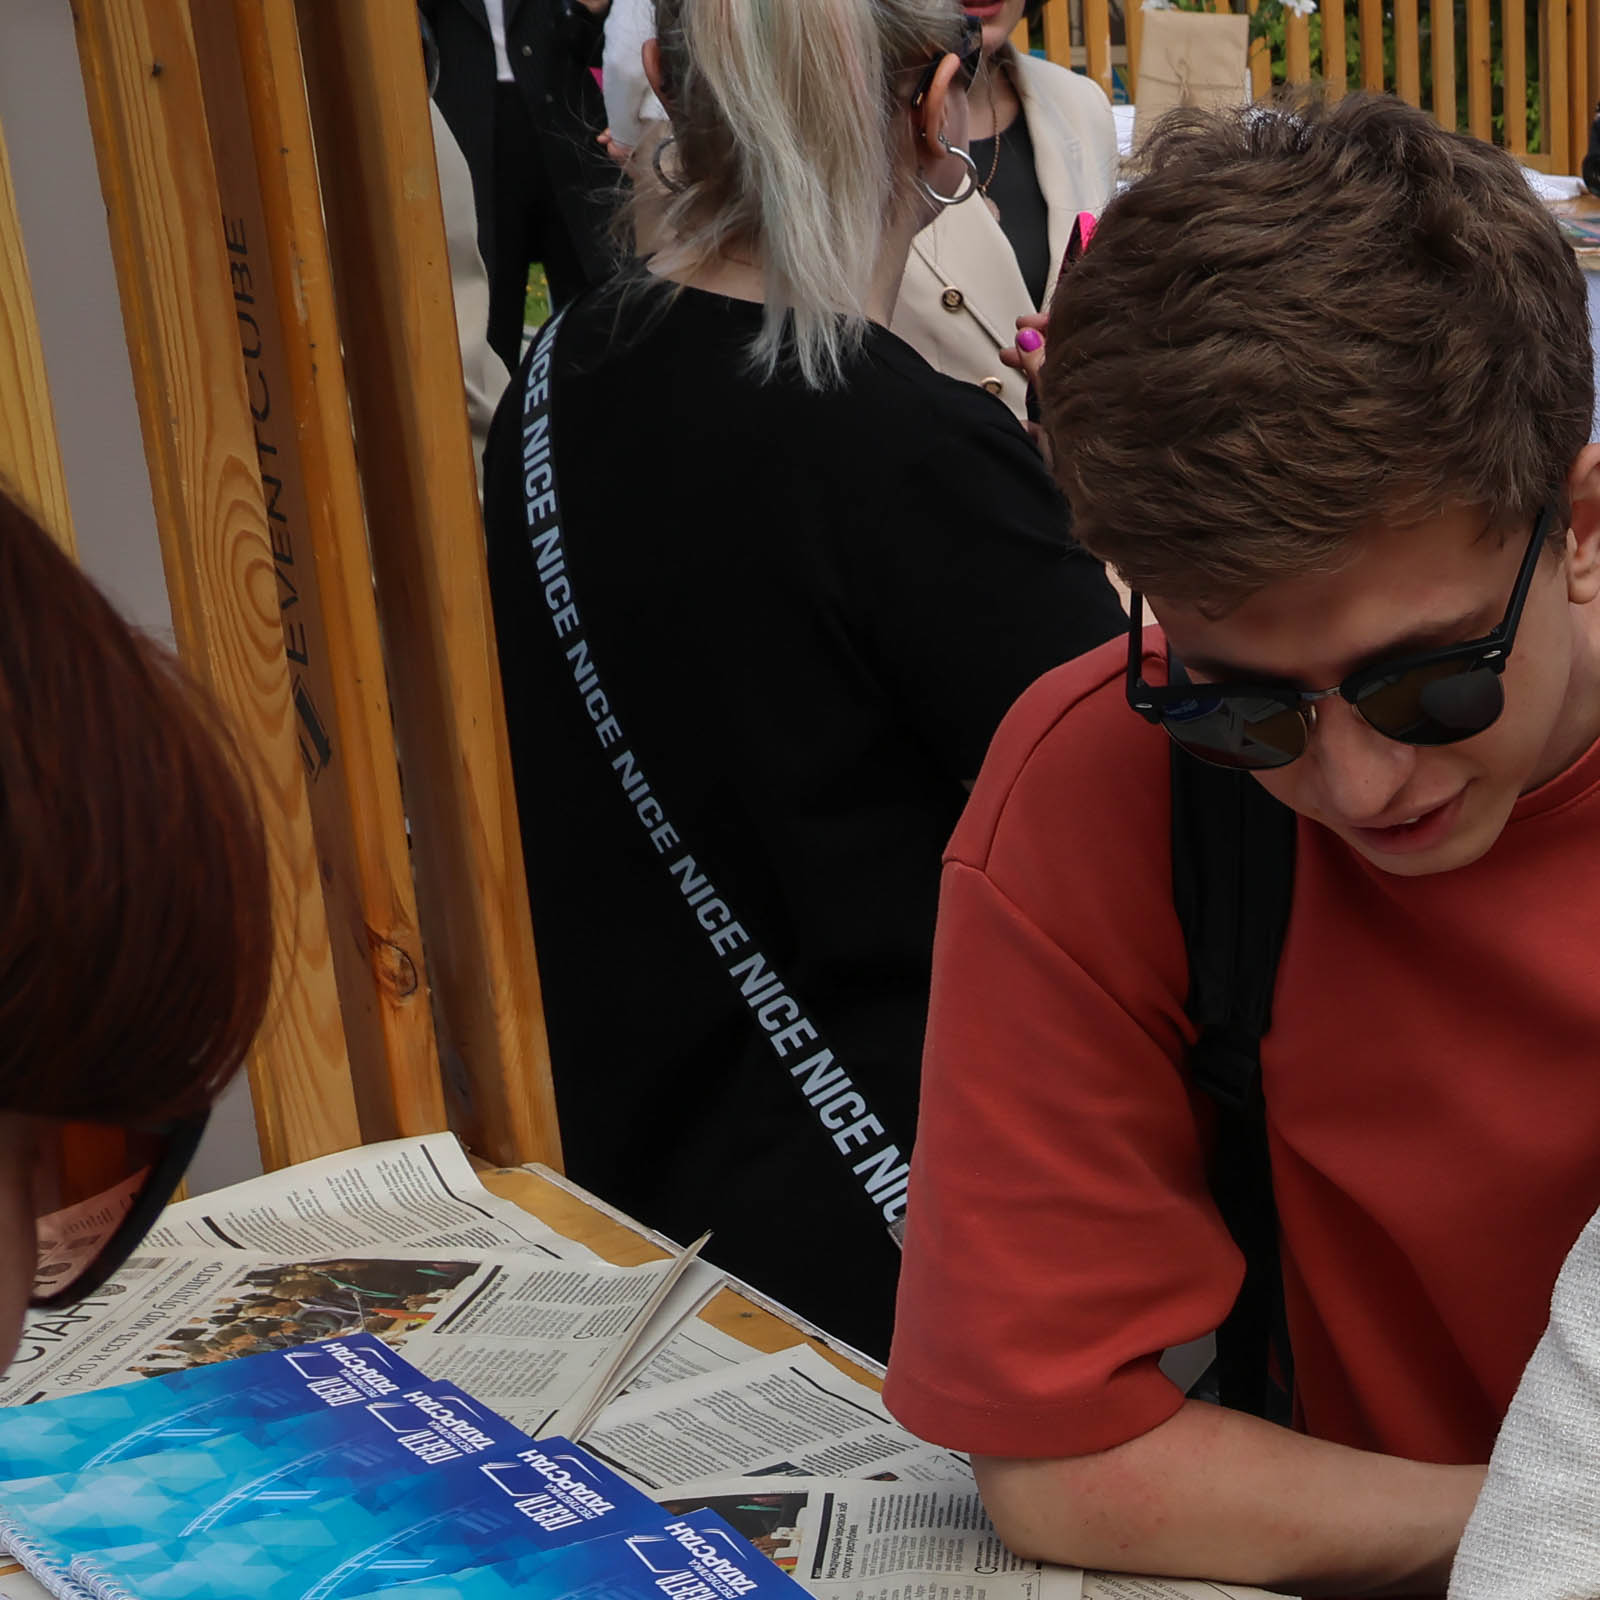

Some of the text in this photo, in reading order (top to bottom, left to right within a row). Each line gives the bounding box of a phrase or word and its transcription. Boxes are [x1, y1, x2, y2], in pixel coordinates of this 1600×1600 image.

[523, 306, 561, 414] NICE
[229, 215, 306, 668] EVENTCUBE
[521, 415, 558, 525] NICE
[531, 526, 581, 639] NICE
[565, 639, 624, 748] NICE
[612, 750, 681, 854] NICE
[669, 853, 750, 956] NICE
[729, 951, 819, 1058] NICE
[789, 1047, 879, 1154] NICE
[54, 1262, 223, 1386] «Это и есть мир будущего»
[305, 1372, 367, 1411] ГАЗЕТА
[321, 1338, 400, 1396] ТАТАРСТАН
[338, 1367, 380, 1399] РЕСПУБЛИКА
[396, 1427, 463, 1466] ГАЗЕТА
[402, 1387, 495, 1451] ТАТАРСТАН
[427, 1418, 476, 1454] РЕСПУБЛИКА
[513, 1491, 582, 1534] ГАЗЕТА
[516, 1447, 615, 1516] ТАТАРСТАН
[543, 1480, 596, 1520] РЕСПУБЛИКА
[663, 1518, 758, 1596] ТАТАРСТАН
[688, 1558, 738, 1600] РЕСПУБЛИКА
